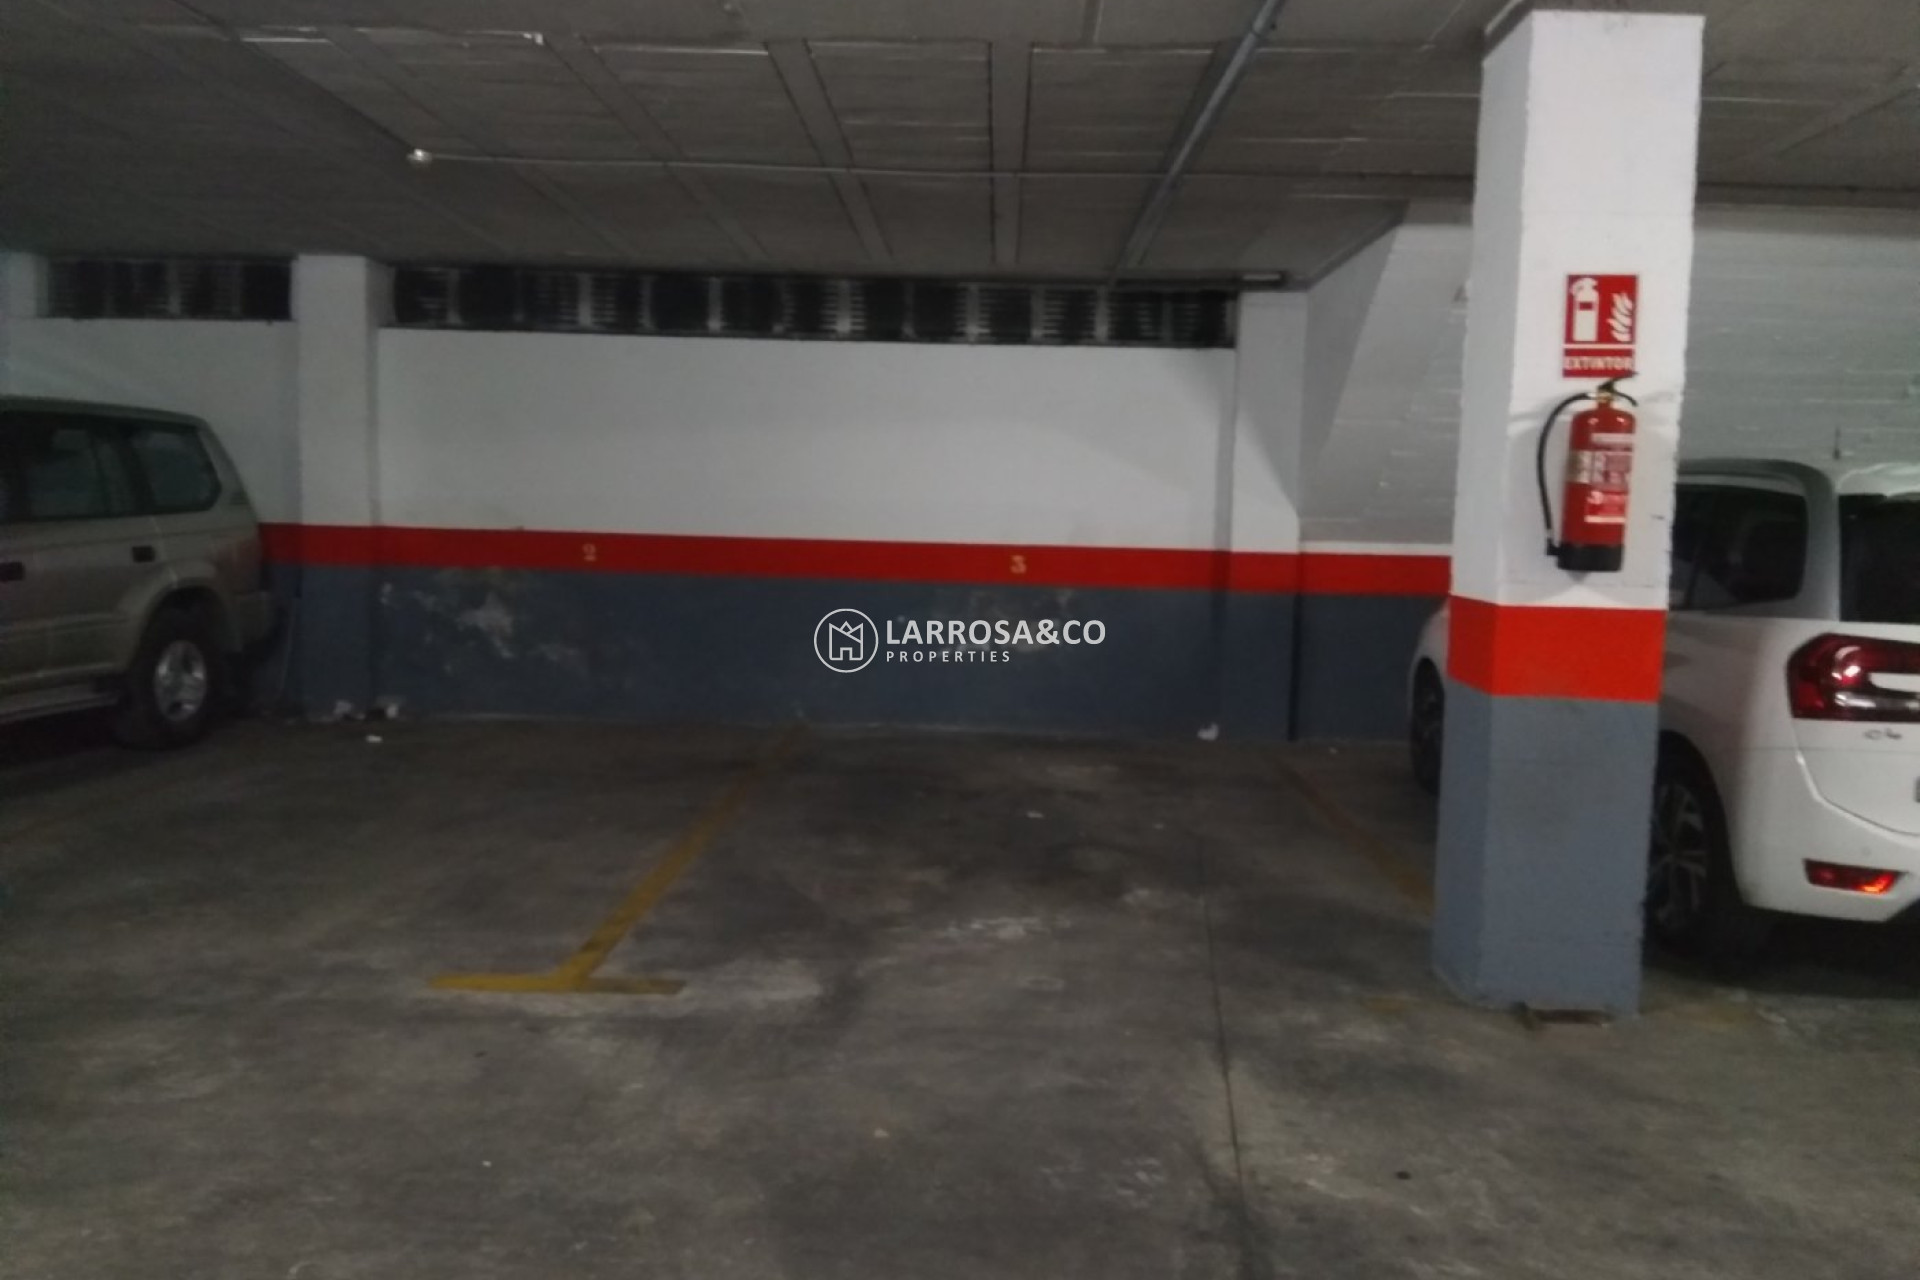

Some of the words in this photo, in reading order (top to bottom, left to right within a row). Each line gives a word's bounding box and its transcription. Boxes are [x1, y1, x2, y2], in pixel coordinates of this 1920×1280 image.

[1564, 356, 1633, 371] EXTINTOR
[582, 543, 597, 561] 2
[1010, 555, 1027, 574] 3
